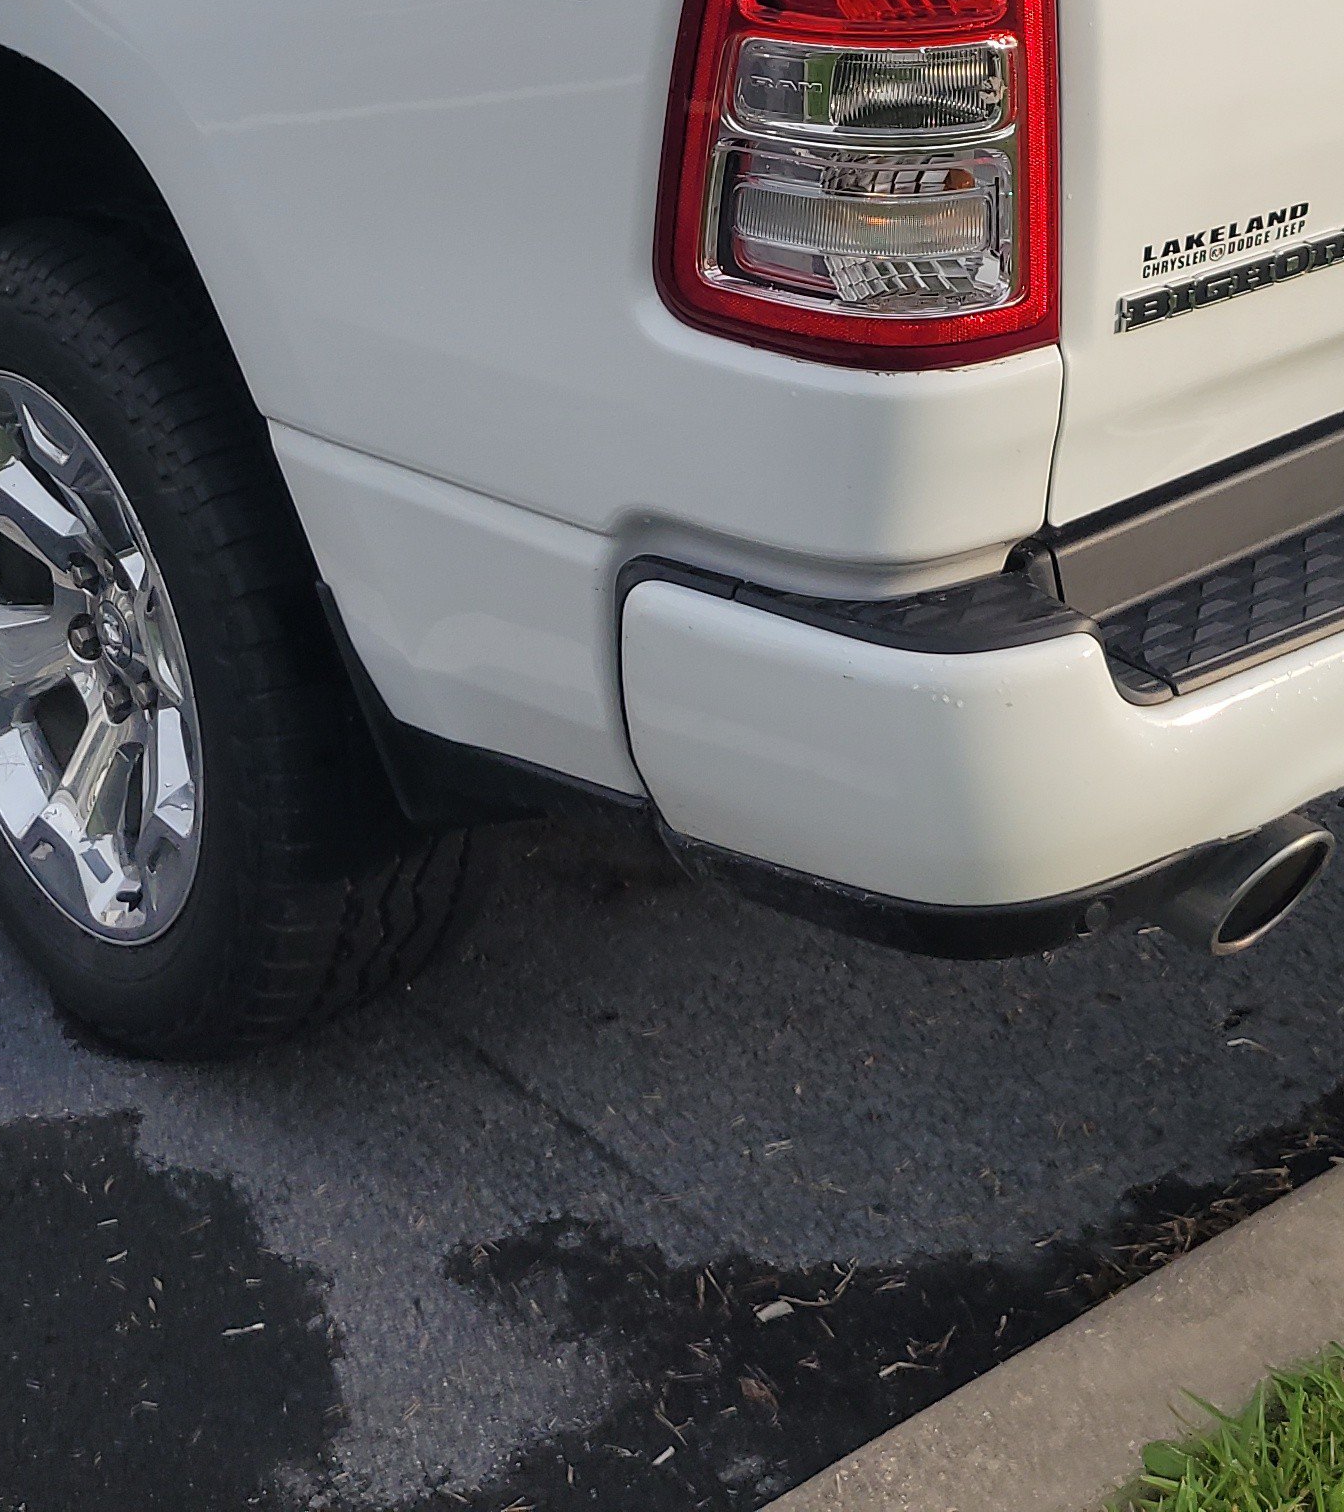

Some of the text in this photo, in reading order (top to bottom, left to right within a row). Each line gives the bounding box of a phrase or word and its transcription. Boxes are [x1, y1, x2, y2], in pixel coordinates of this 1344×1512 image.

[1142, 201, 1310, 264] LAKELAND
[1142, 220, 1306, 280] CHRYSLER DODGE JEEP
